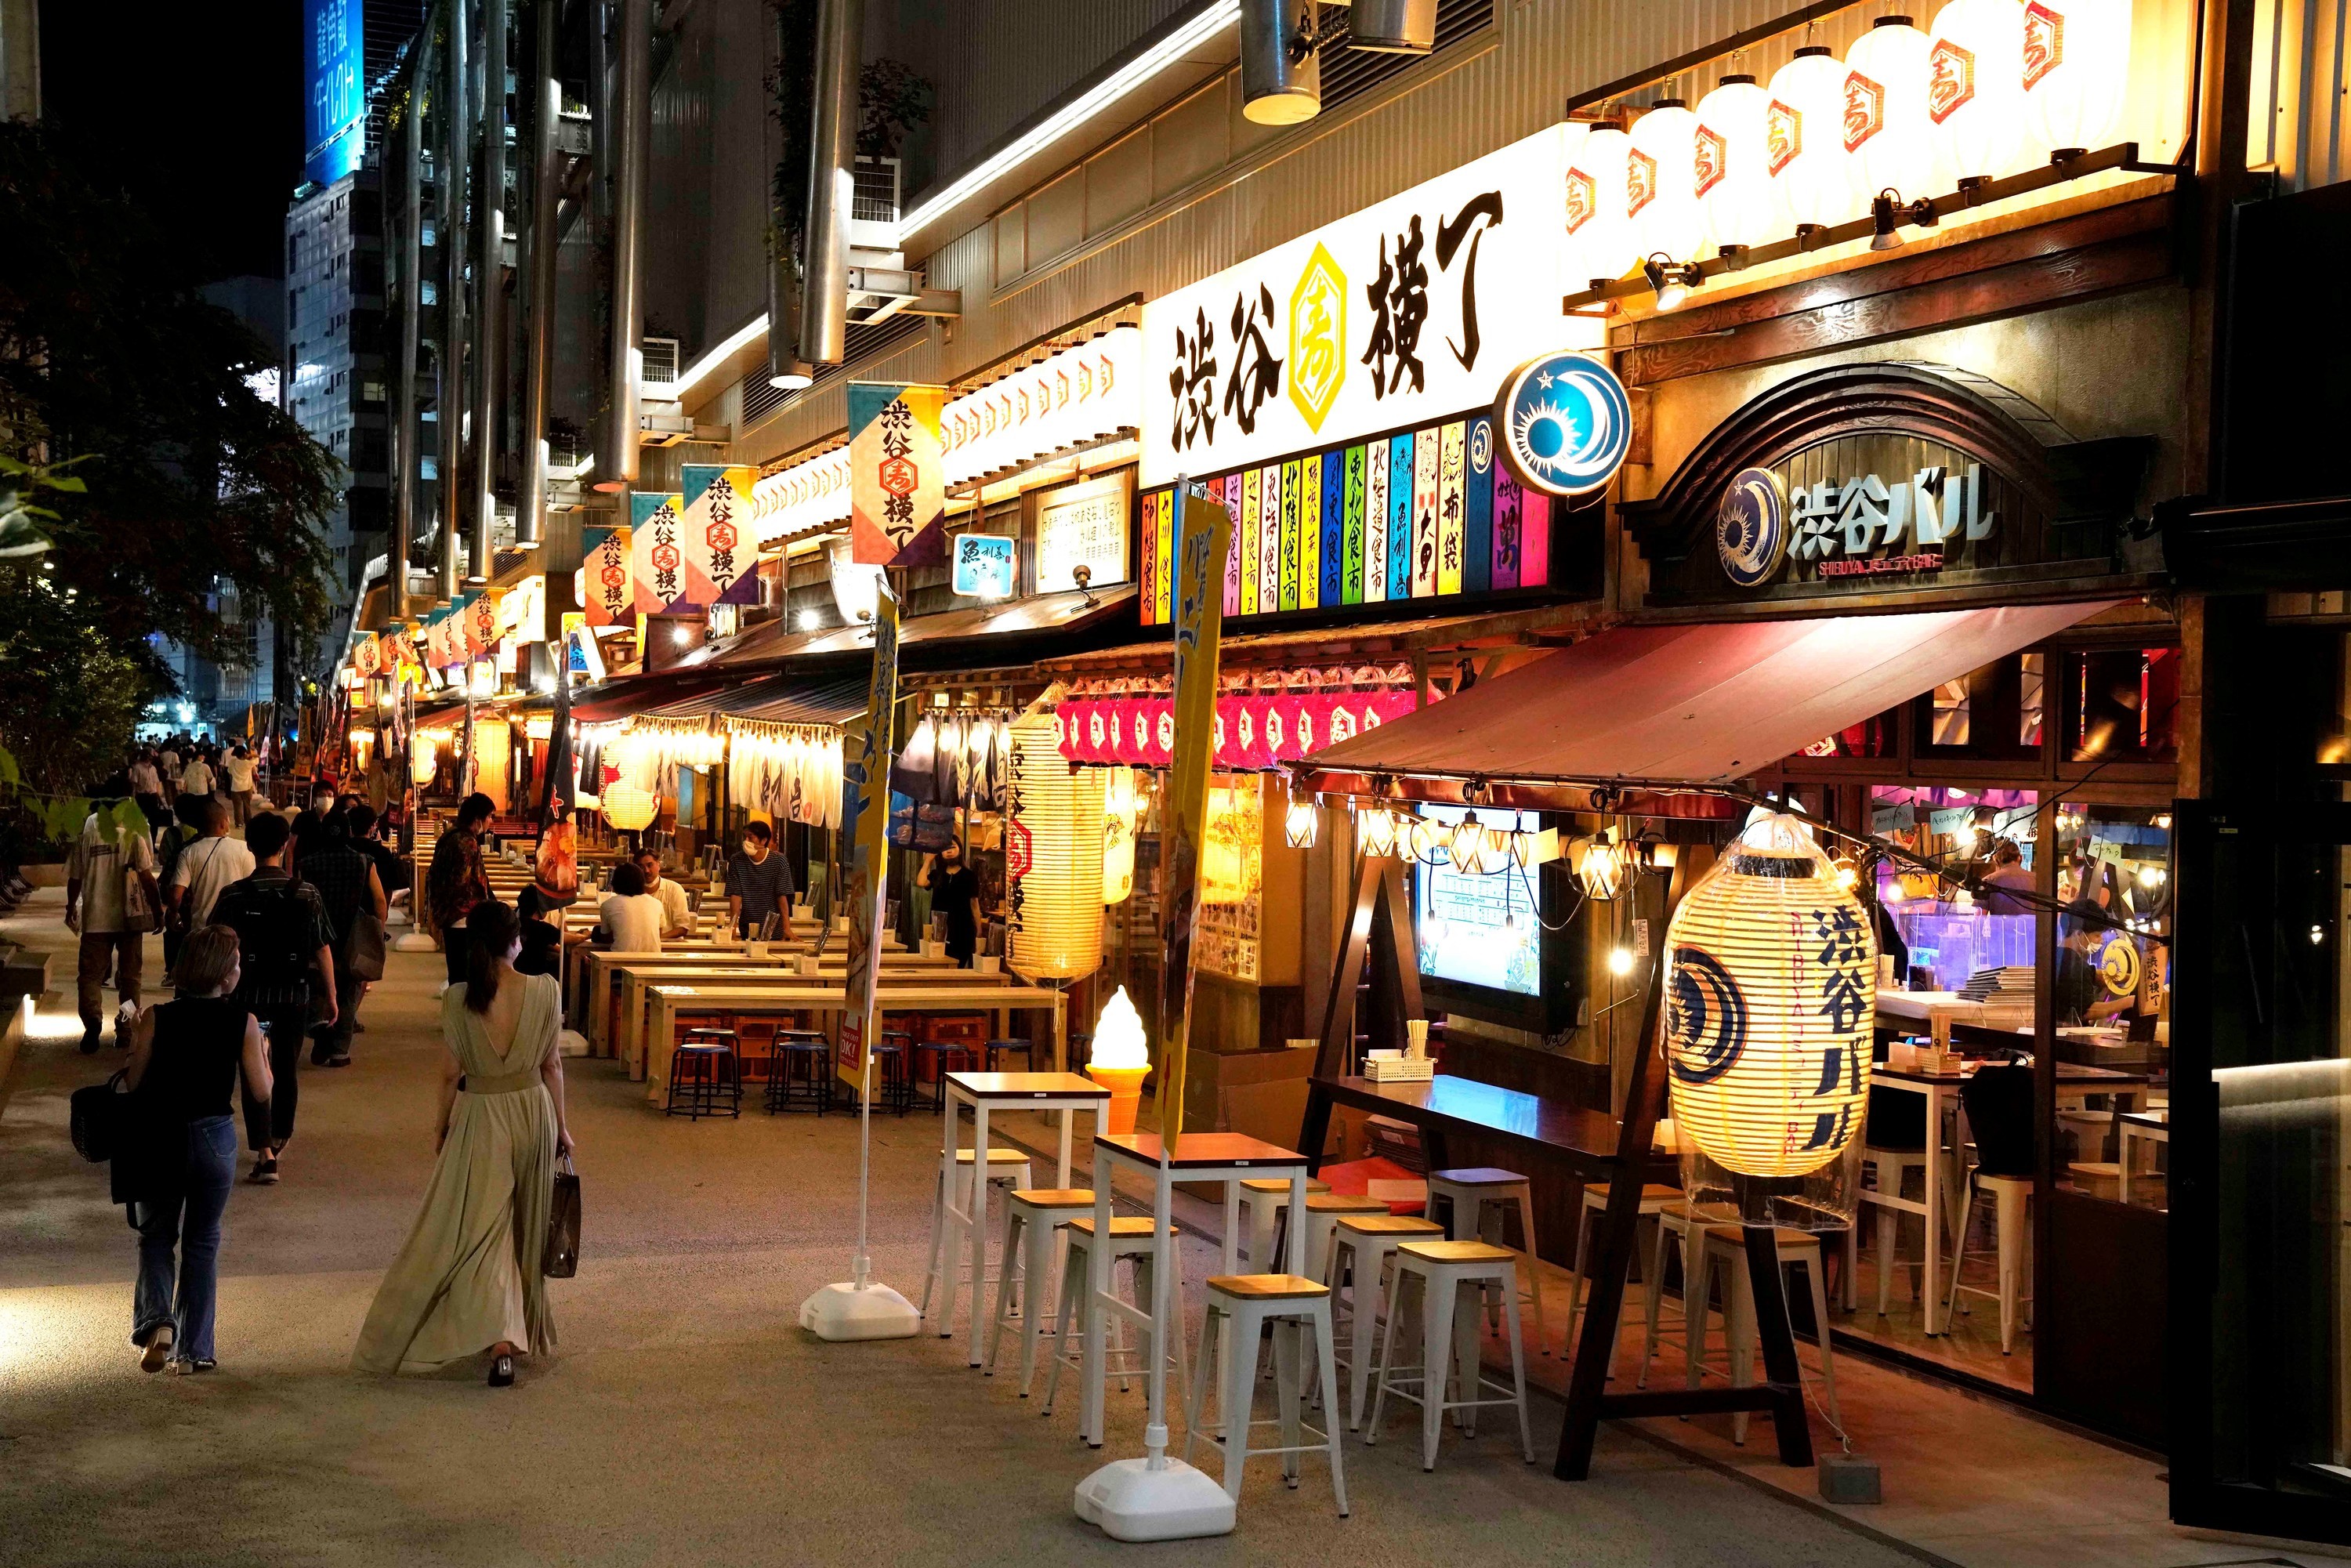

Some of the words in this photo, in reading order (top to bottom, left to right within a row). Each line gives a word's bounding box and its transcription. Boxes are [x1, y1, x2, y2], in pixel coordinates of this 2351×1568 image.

[1283, 463, 1298, 606] 北陸食市
[1347, 447, 1363, 599] 東北食市
[1371, 444, 1386, 595] 北海道食市
[1442, 487, 1459, 571] 布袋
[1787, 463, 1999, 560] 渋谷バル
[1819, 559, 1866, 576] SHIBUYA
[1791, 911, 1803, 1017] SHIBUYA
[1801, 904, 1867, 1150] 渋谷バル
[1784, 1122, 1799, 1155] BAR
